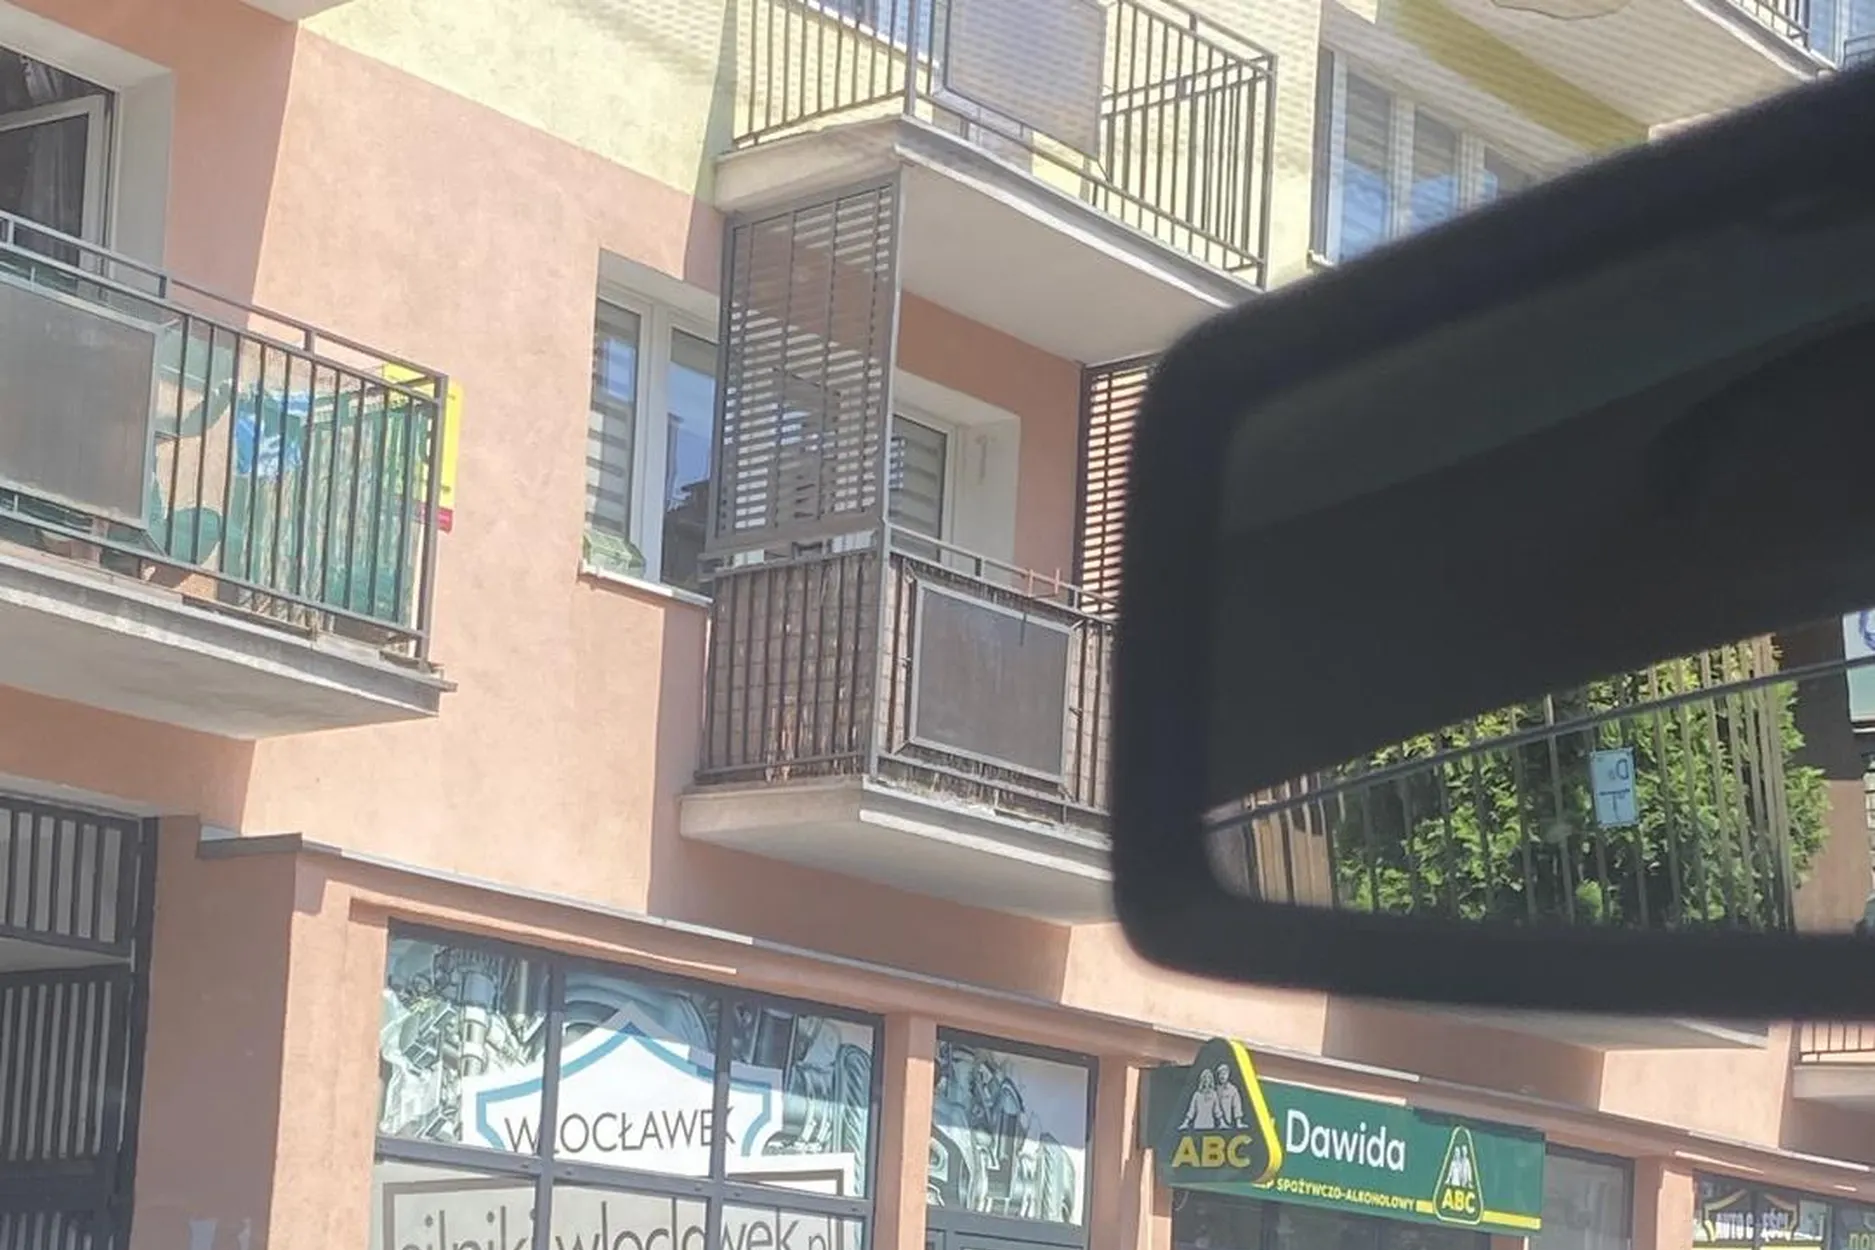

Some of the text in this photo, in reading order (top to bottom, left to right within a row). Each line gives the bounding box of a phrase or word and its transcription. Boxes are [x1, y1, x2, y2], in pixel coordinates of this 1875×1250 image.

[503, 1106, 736, 1155] WOCŁAWEK
[1285, 1108, 1407, 1172] Dawida
[1171, 1134, 1253, 1168] ABC
[1276, 1177, 1415, 1211] SPOŻYWCZO-ALKOHOLOWY
[1442, 1188, 1476, 1214] ABC
